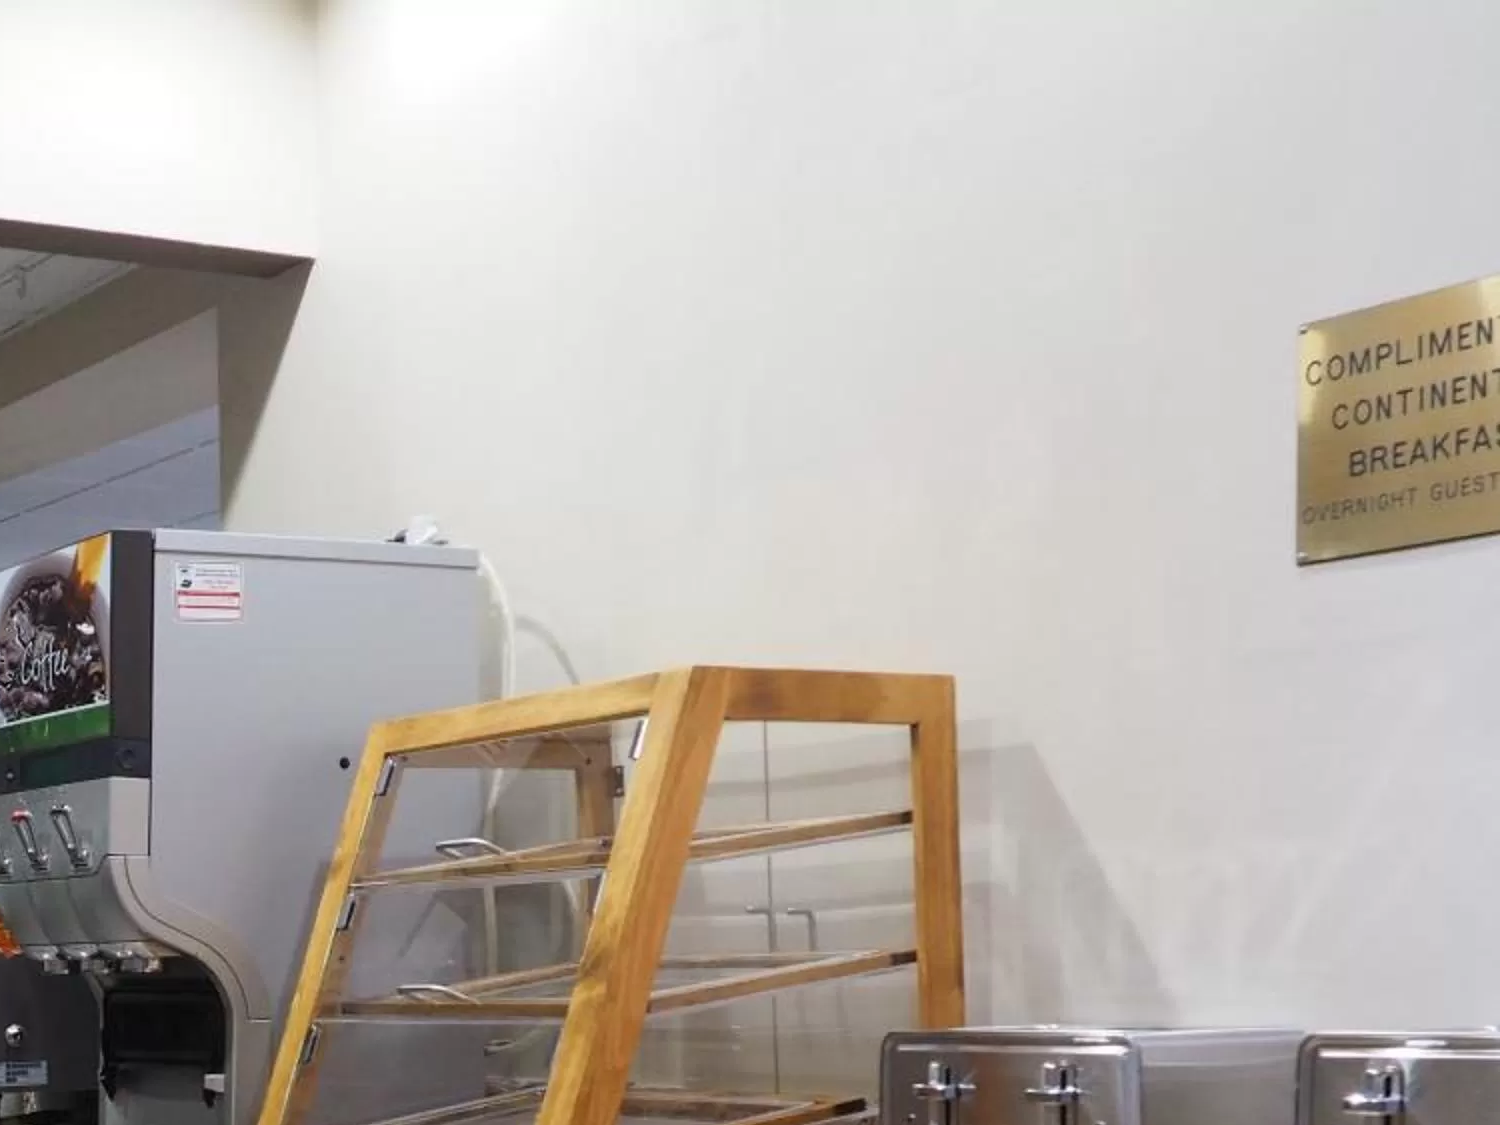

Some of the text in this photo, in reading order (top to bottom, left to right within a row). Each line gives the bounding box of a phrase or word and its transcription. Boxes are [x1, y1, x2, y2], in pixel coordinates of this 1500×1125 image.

[1305, 315, 1500, 386] COMPLIMEN
[1302, 470, 1500, 525] OVERNIGHT GUEST
